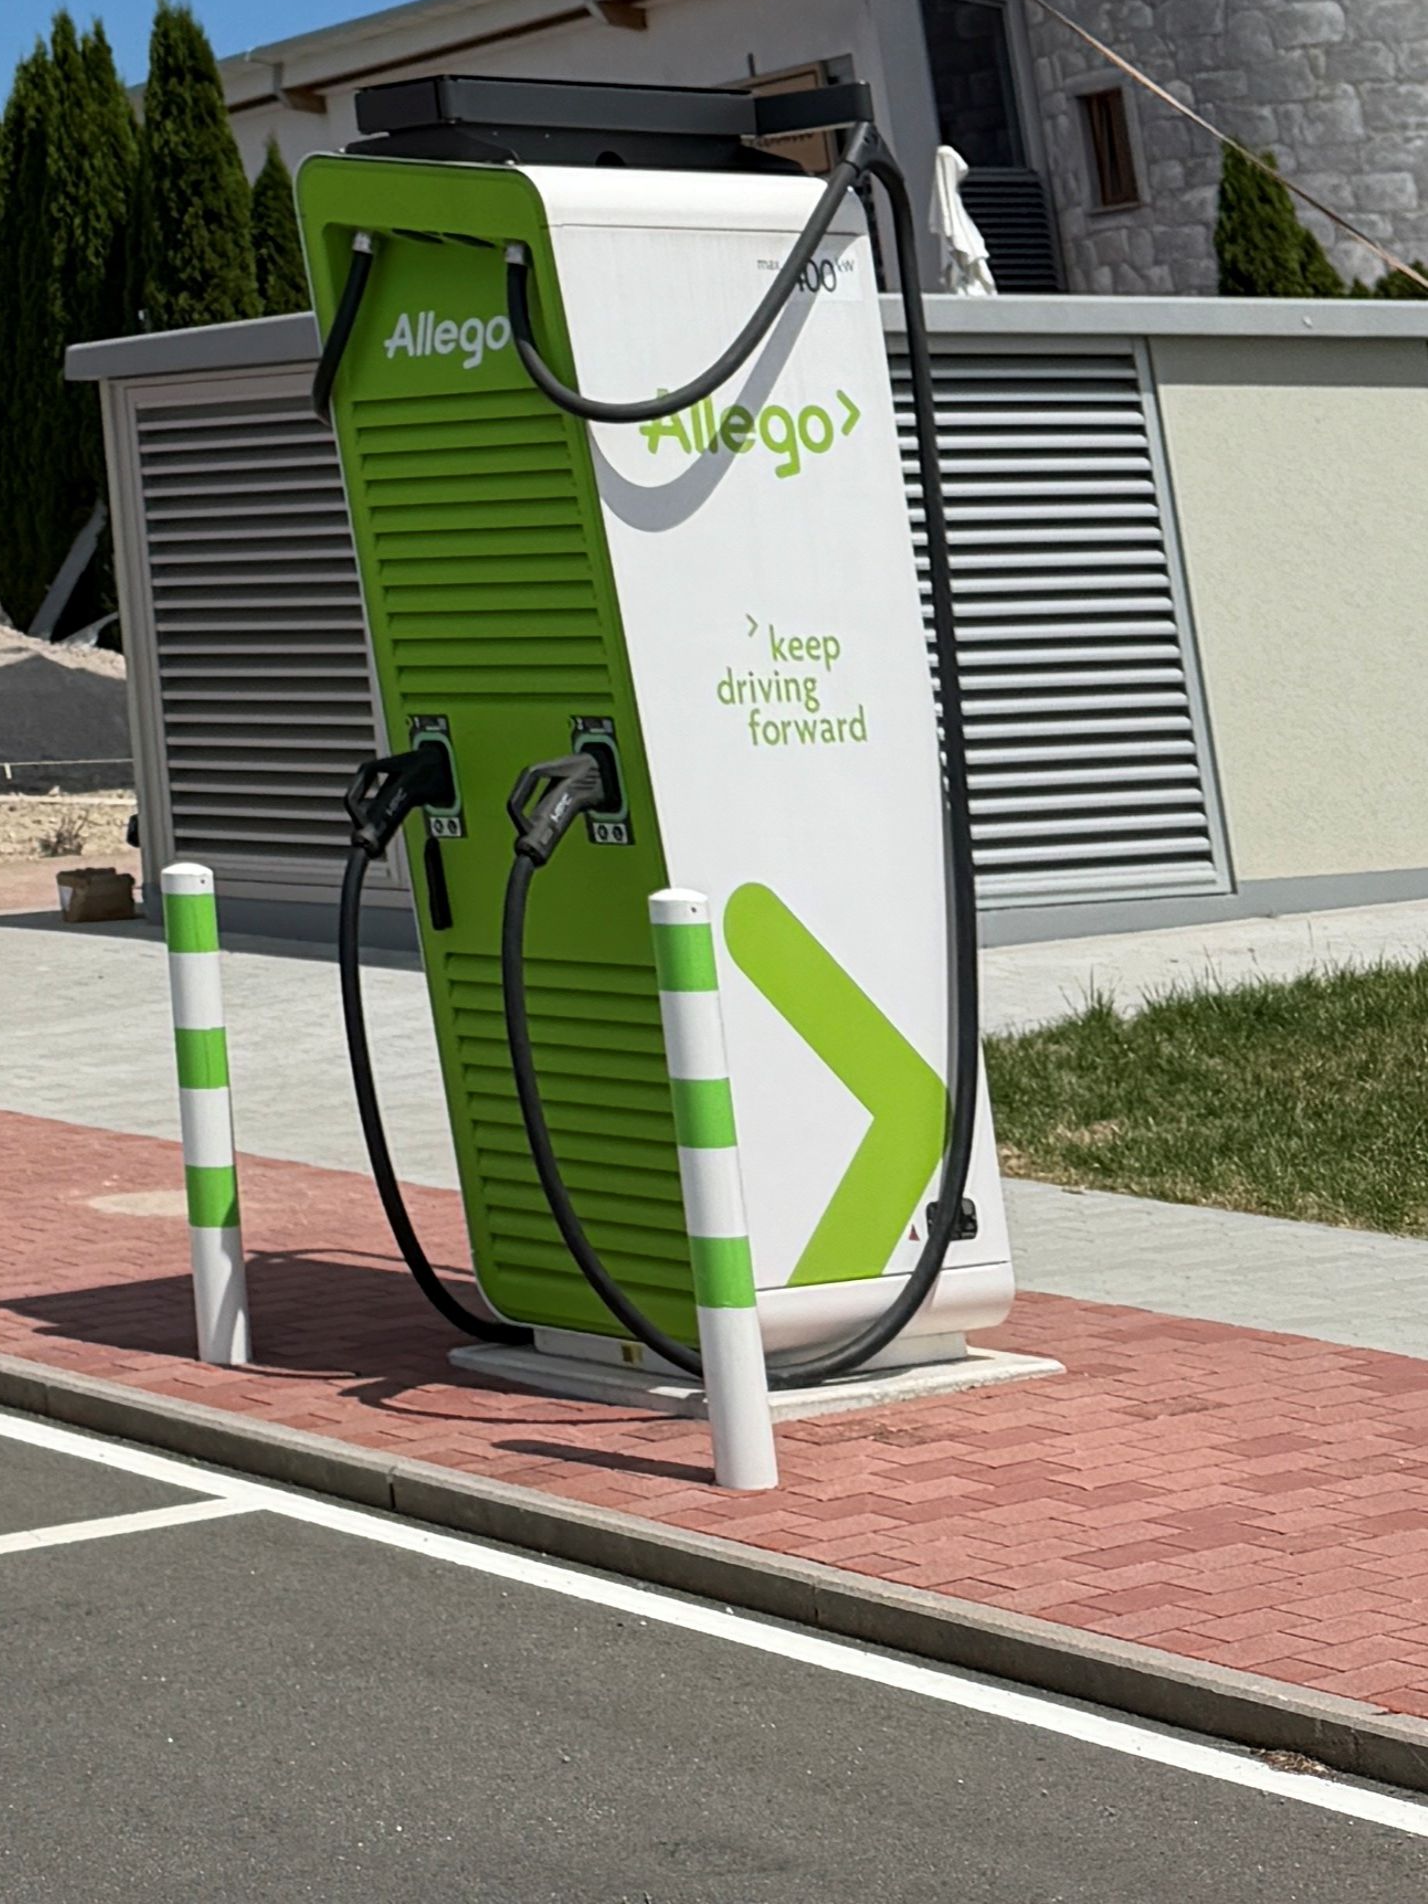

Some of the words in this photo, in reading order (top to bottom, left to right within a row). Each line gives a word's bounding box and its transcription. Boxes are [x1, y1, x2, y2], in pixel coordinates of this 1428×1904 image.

[384, 310, 512, 370] Allego
[638, 388, 835, 479] Allego
[769, 624, 841, 671] keep
[716, 667, 819, 711] driving
[747, 705, 869, 747] forward
